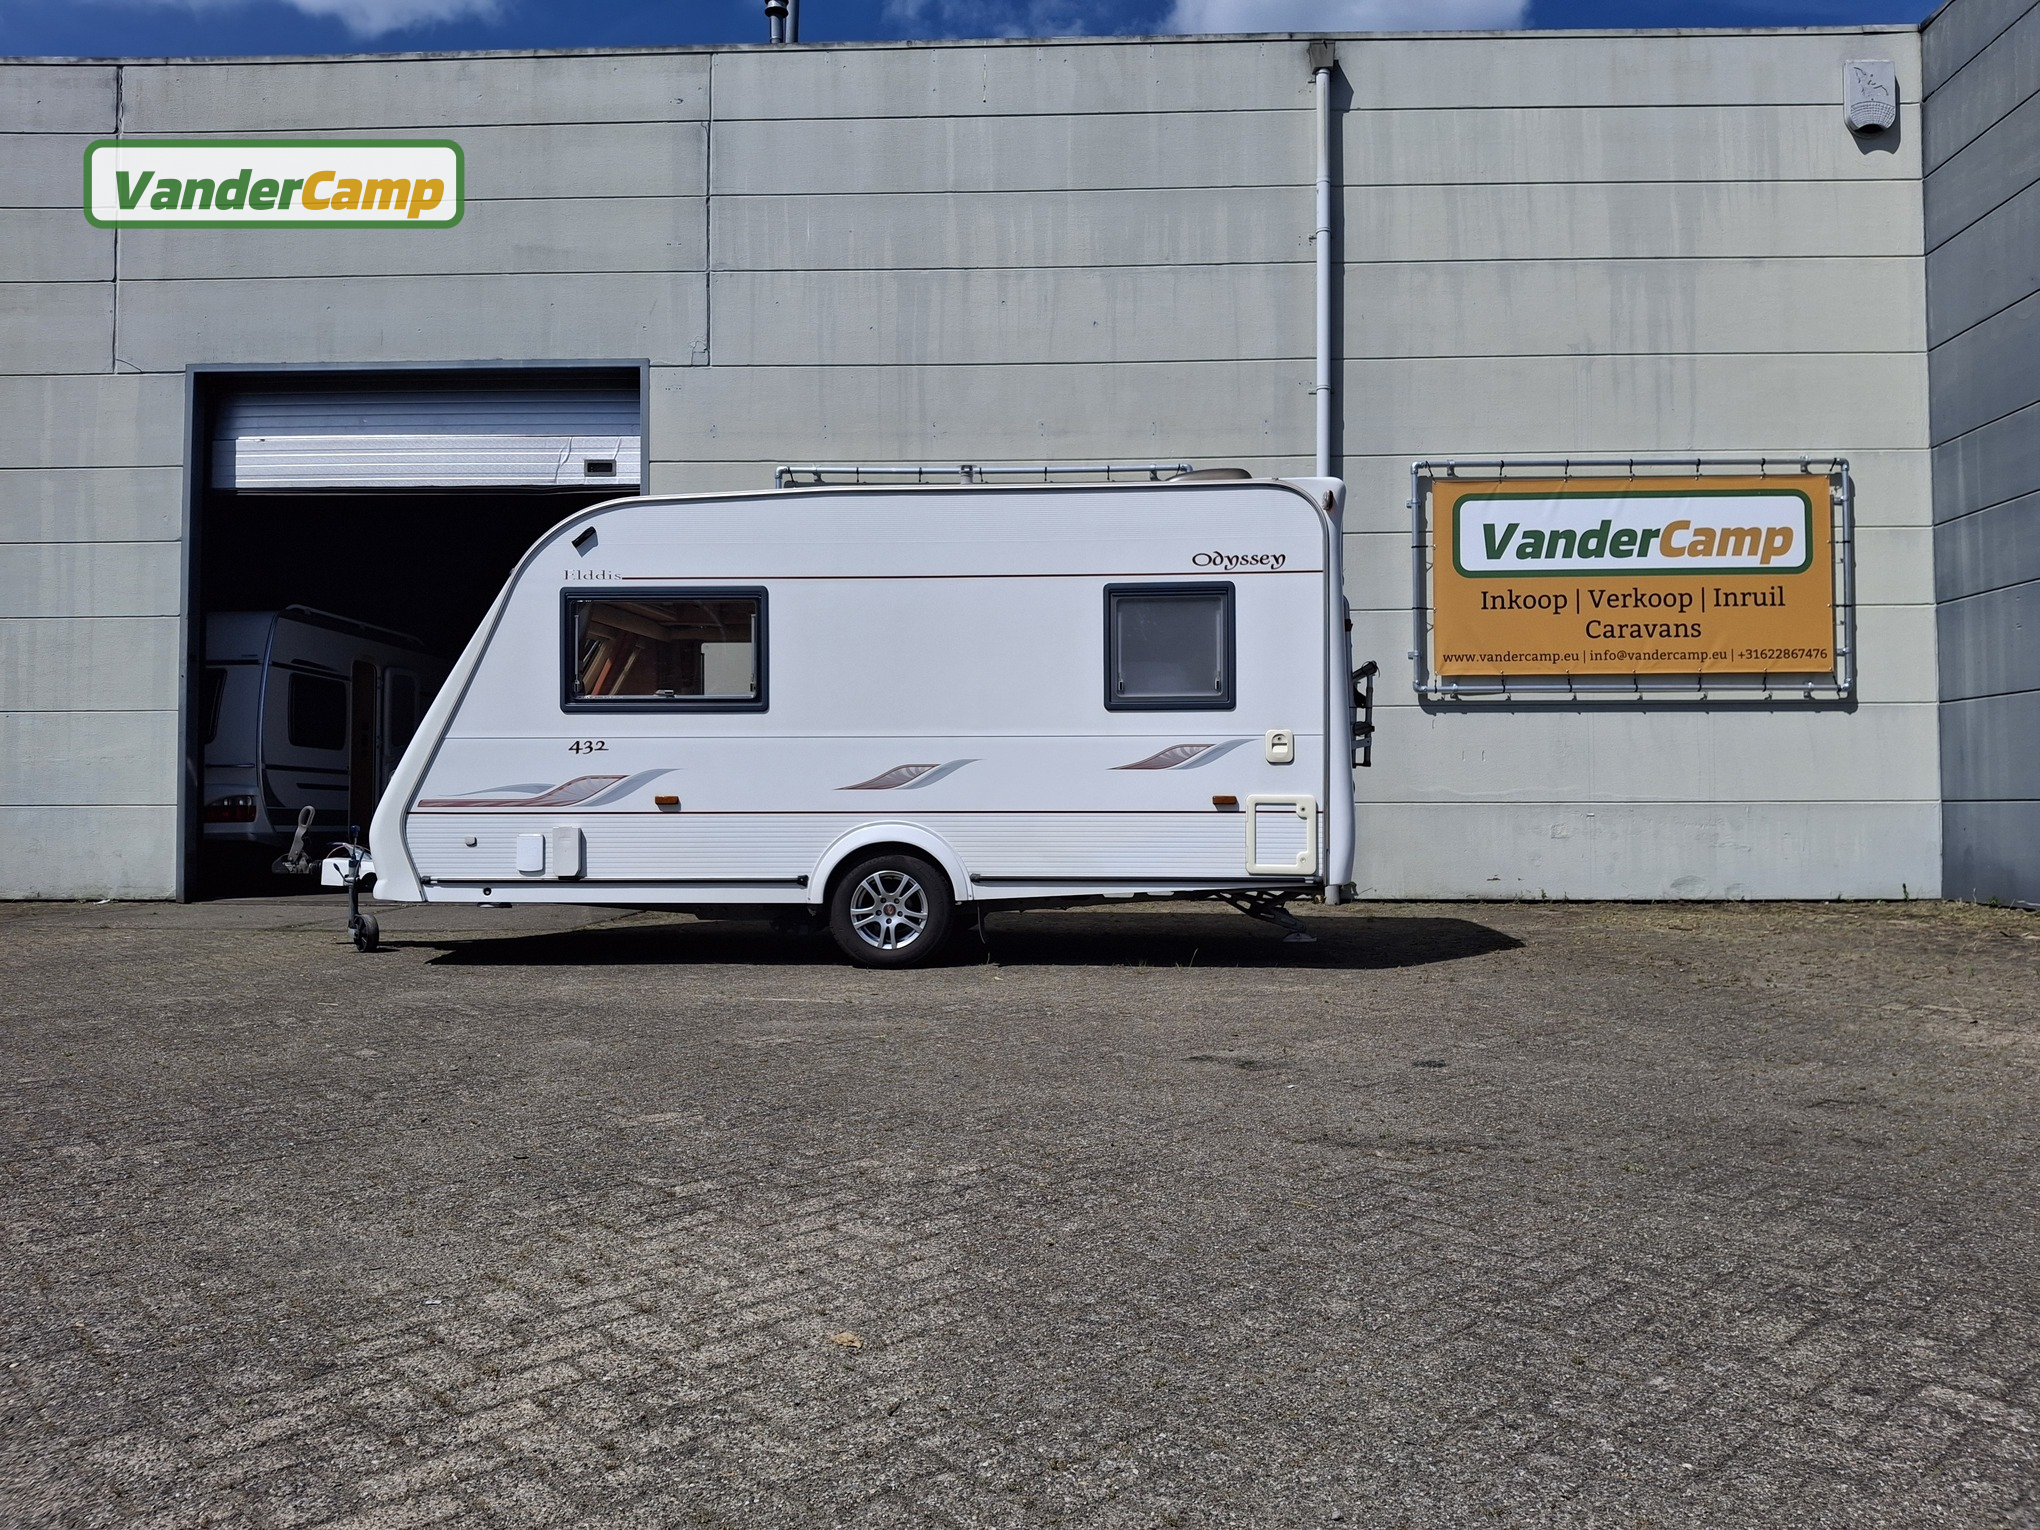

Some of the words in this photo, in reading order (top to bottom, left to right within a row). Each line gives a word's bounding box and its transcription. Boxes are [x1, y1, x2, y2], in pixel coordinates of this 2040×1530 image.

[1482, 519, 1794, 565] VanderCamp
[1191, 550, 1286, 571] Odyssey
[564, 569, 622, 580] Elddis
[1480, 589, 1568, 615] Inkoop
[1588, 587, 1693, 613] Verkoop
[1713, 586, 1786, 607] Inruil
[1585, 619, 1702, 639] Caravans
[1442, 650, 1579, 664] www.vandercamp.eu
[1589, 649, 1727, 663] info@vandercamp.eu
[1737, 648, 1828, 660] +31622867476
[568, 740, 609, 755] 432
